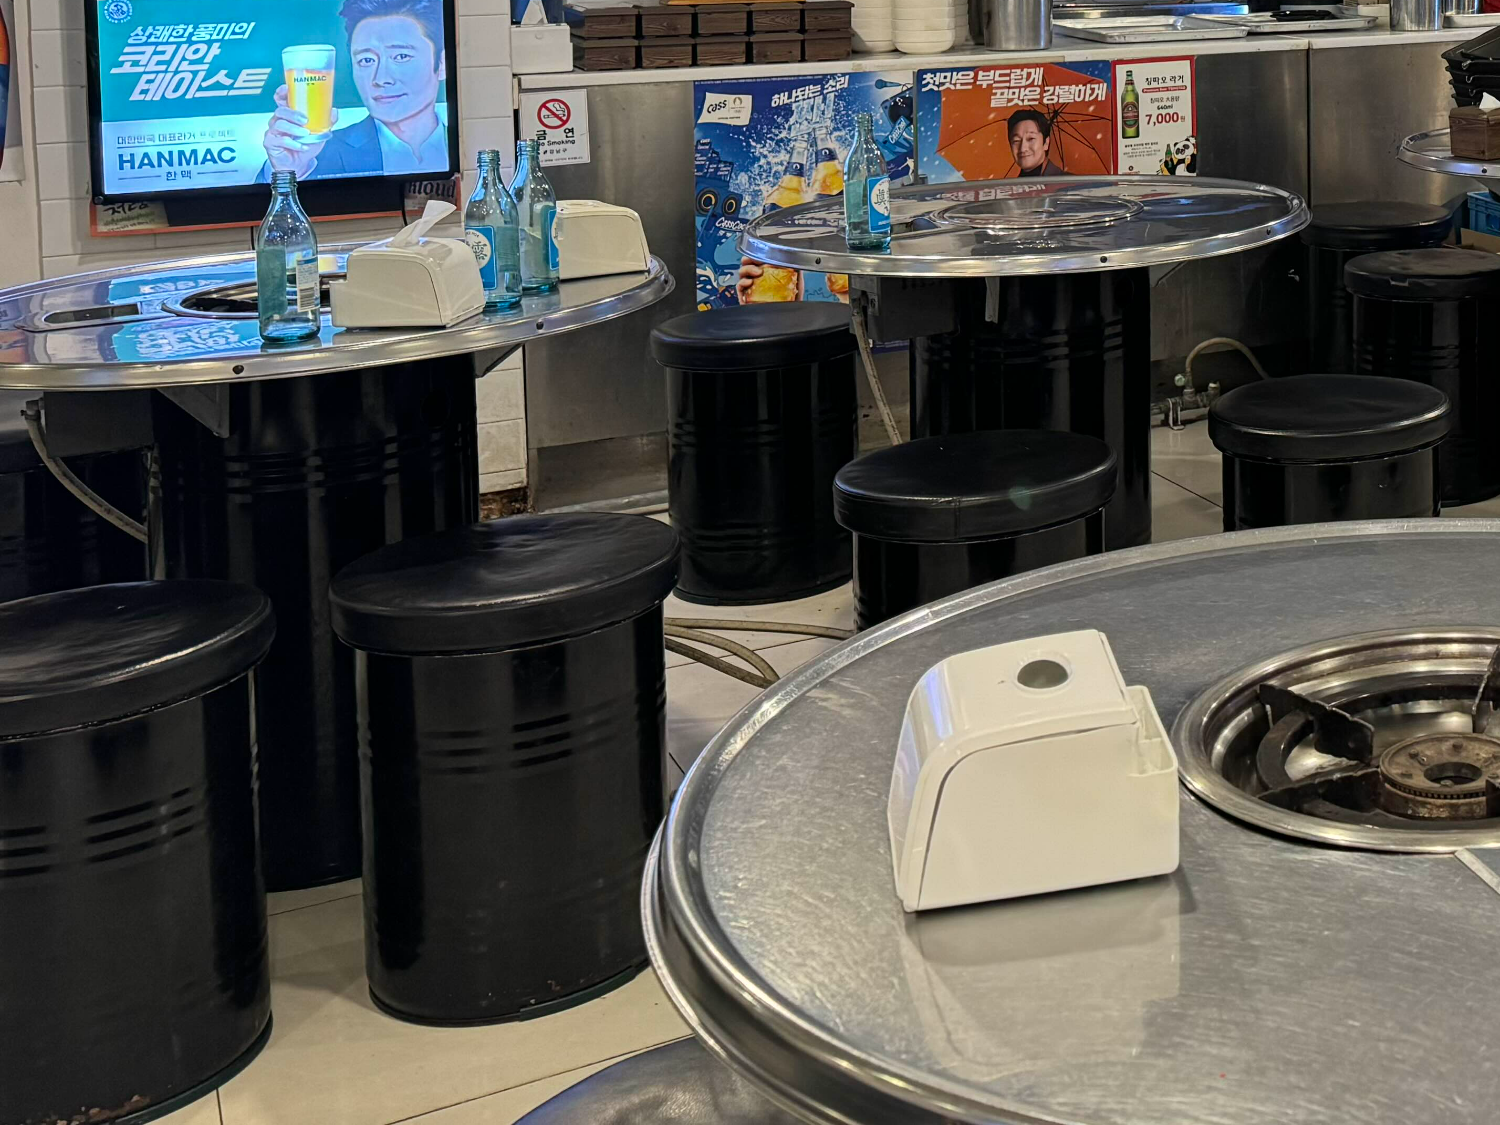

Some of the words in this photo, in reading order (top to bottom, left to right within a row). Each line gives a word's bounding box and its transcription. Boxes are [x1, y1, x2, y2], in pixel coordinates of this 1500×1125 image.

[127, 24, 194, 44] 상쾌한
[191, 22, 257, 42] 풍미의
[110, 42, 223, 74] 코리안
[129, 67, 273, 101] 테이스트
[294, 75, 328, 83] HANMAC
[921, 71, 974, 92] 첫맛은
[976, 67, 1044, 89] 부드럽게
[1145, 76, 1168, 86] 칭따오
[771, 83, 822, 108] 하나되는
[823, 74, 850, 94] 소리
[990, 86, 1041, 108] 끝맛은
[1043, 82, 1107, 104] 강렬하게
[706, 99, 727, 115] Cass
[1145, 111, 1180, 127] 7,000
[117, 135, 156, 146] 대한민국
[158, 131, 197, 143] 대표라거
[547, 139, 576, 147] Smoking
[118, 146, 238, 171] HANMAC
